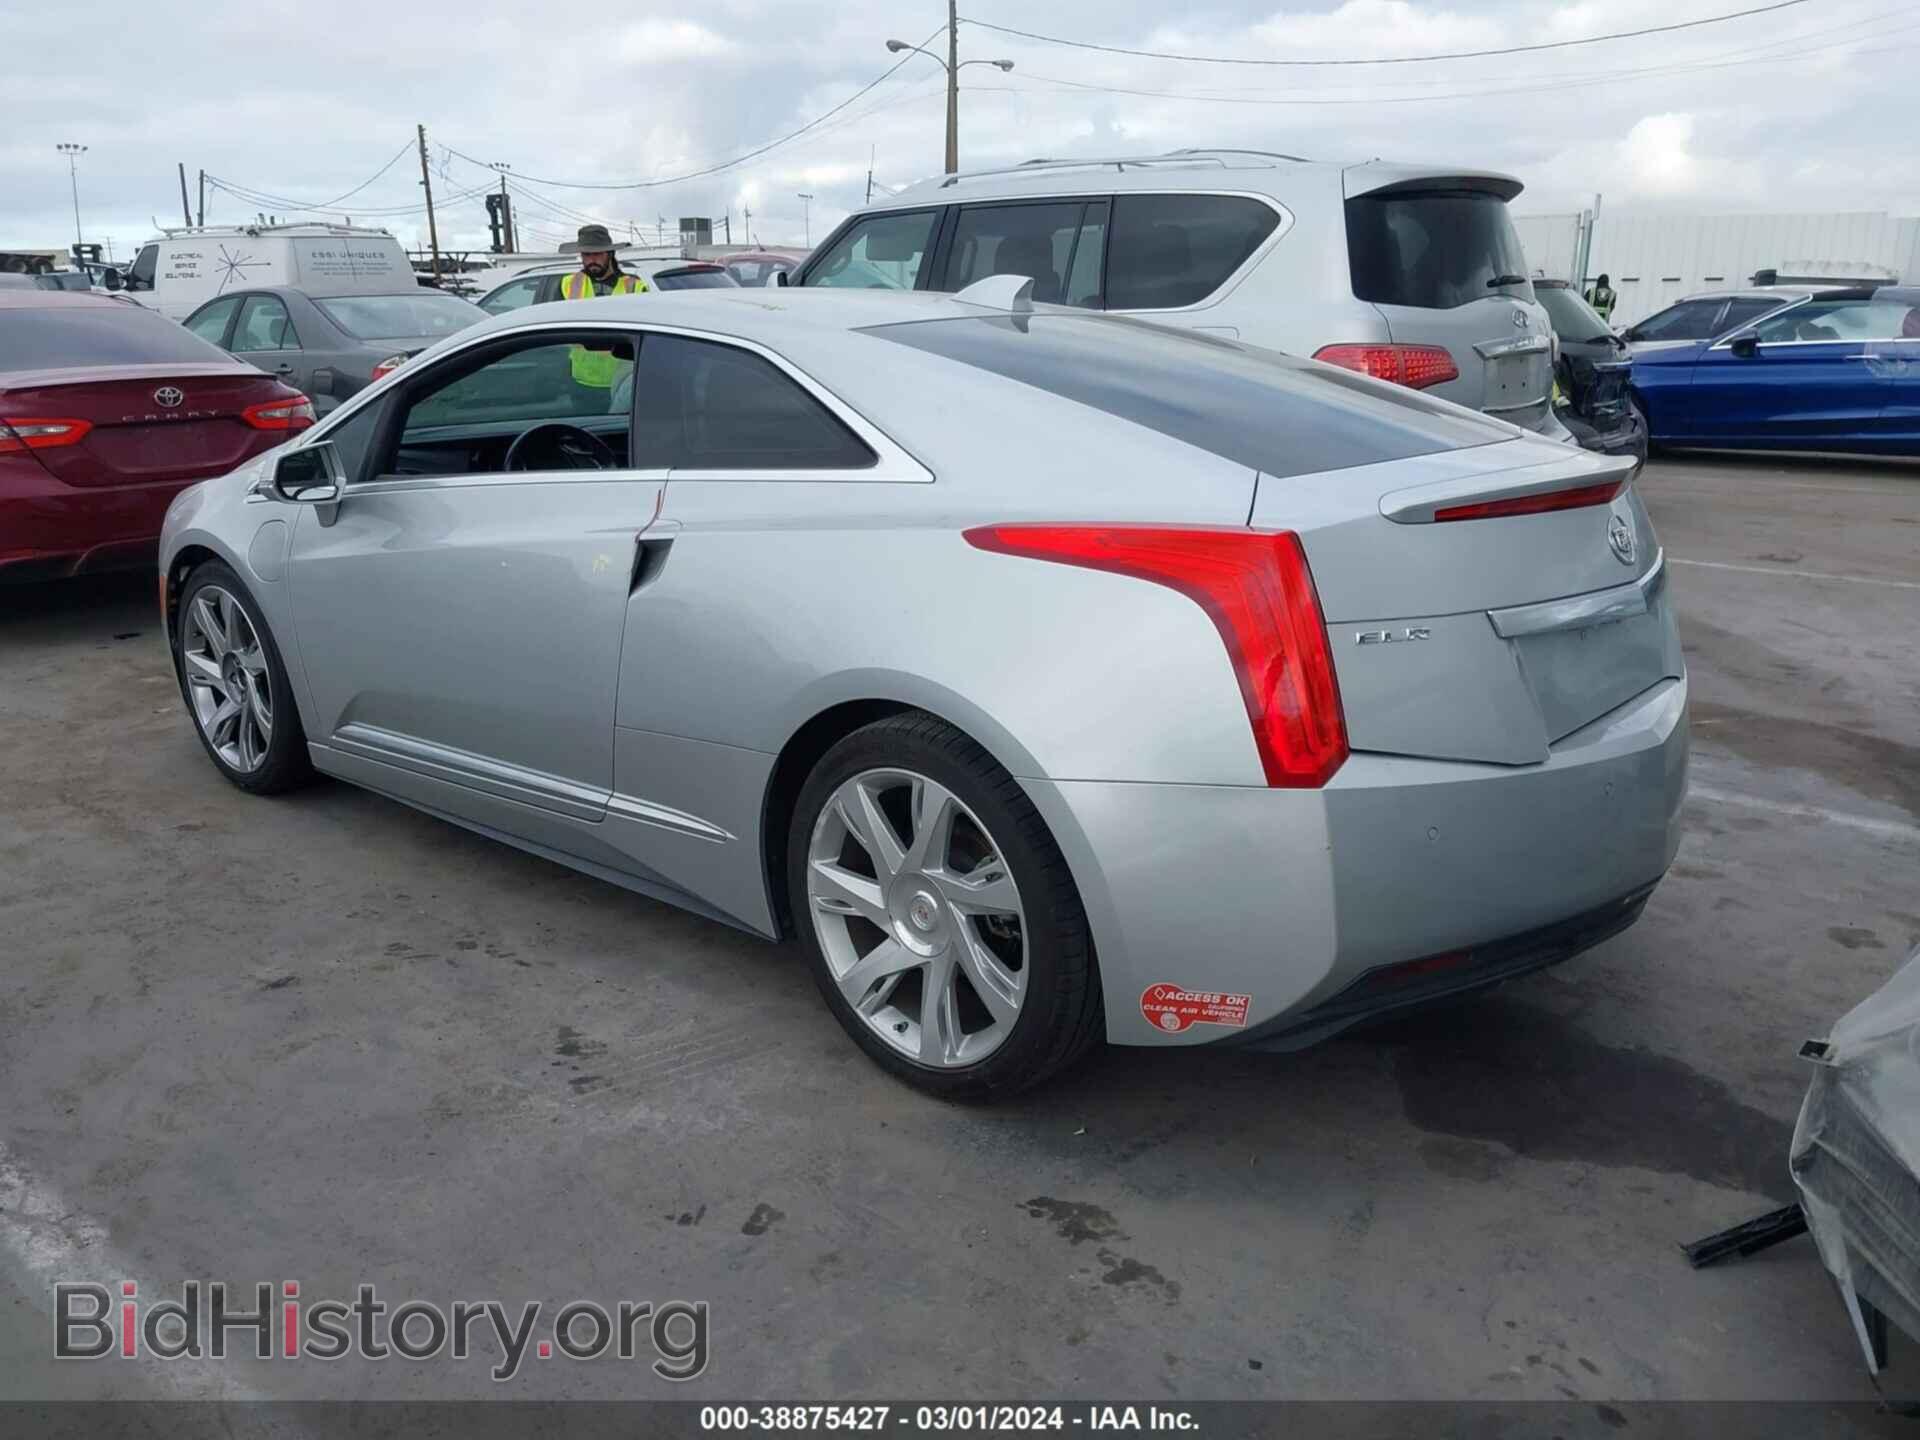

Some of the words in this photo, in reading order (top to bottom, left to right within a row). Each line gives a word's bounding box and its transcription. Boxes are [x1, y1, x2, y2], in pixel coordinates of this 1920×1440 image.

[1355, 627, 1431, 645] ELR
[1166, 991, 1221, 1004] ACCESS
[1226, 996, 1246, 1006] OK
[1143, 1004, 1178, 1013] CLEAN
[1180, 1007, 1198, 1015] AIR
[1201, 1009, 1243, 1019] VEHICLE
